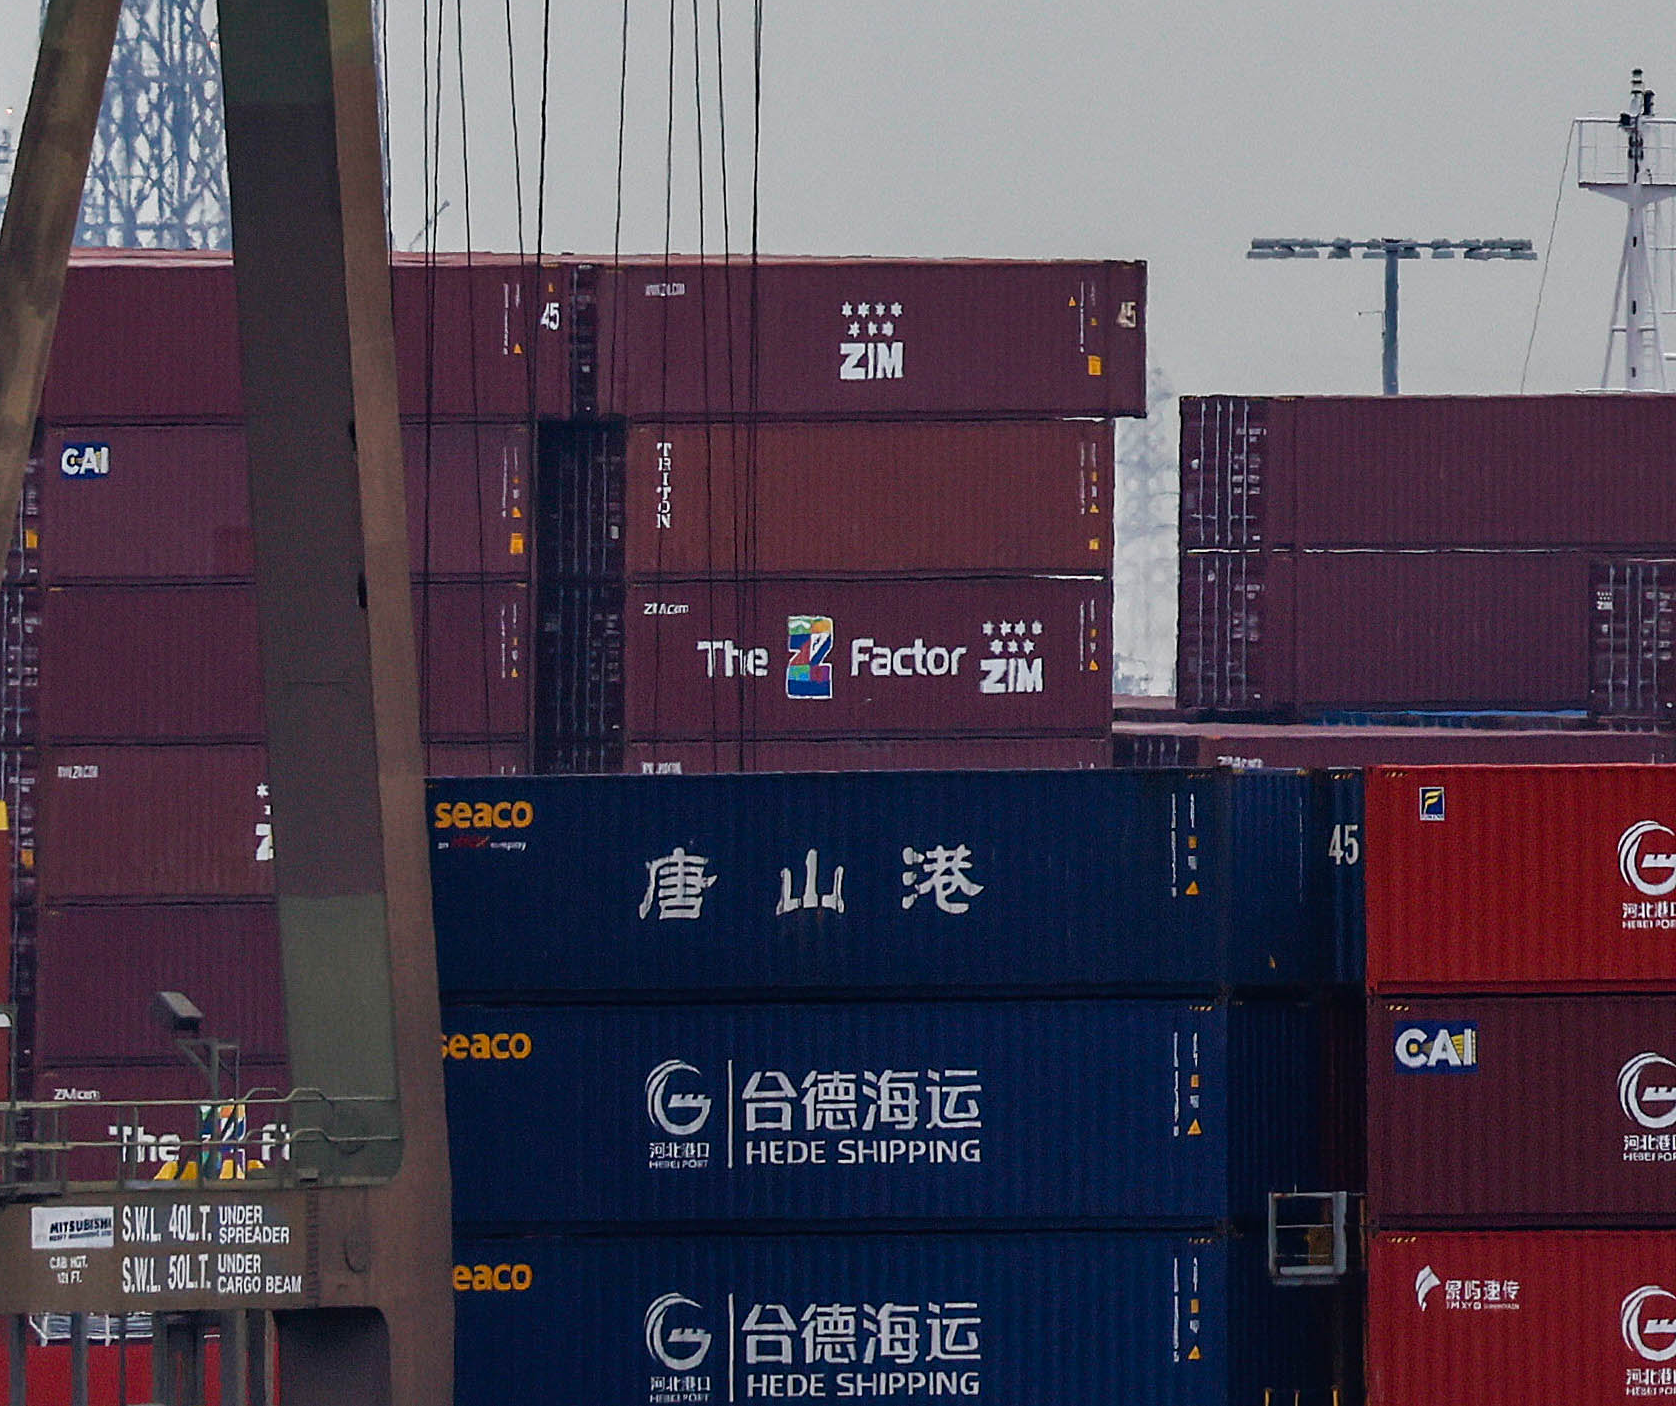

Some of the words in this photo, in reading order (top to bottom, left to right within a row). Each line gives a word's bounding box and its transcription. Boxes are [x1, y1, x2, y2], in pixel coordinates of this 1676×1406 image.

[540, 301, 560, 331] 45
[1117, 301, 1137, 328] 45
[839, 341, 904, 381] ZIM
[61, 446, 109, 476] CAI
[656, 441, 673, 529] TRITON
[696, 638, 770, 679] The
[849, 637, 968, 678] Factor
[979, 656, 1044, 695] ZIM
[434, 800, 534, 829] seaco
[1328, 823, 1359, 866] 45
[639, 846, 718, 921] 唐
[775, 848, 845, 917] 山
[901, 844, 985, 915] 港
[1395, 1028, 1472, 1068] CAI
[741, 1069, 982, 1131] 台德海运
[109, 1124, 180, 1163] The
[746, 1140, 827, 1165] HEDE
[837, 1140, 981, 1164] SHIPPING
[50, 1218, 112, 1234] MITSUBISHI
[122, 1206, 161, 1242] S.W.L.
[168, 1204, 212, 1241] 40L.T.
[219, 1205, 263, 1224] UNDER
[219, 1227, 290, 1244] SPREADER
[49, 1256, 67, 1269] CAB
[70, 1271, 83, 1284] FT.
[122, 1257, 161, 1293] S.W.L.
[167, 1254, 212, 1290] 50L.T.
[218, 1254, 261, 1273] UNDER
[452, 1263, 533, 1291] eaco
[218, 1277, 261, 1293] CARGO
[265, 1275, 302, 1293] BEAM
[741, 1302, 981, 1364] 台德海运
[747, 1374, 825, 1397] HEDE
[836, 1373, 980, 1397] SHIPPING
